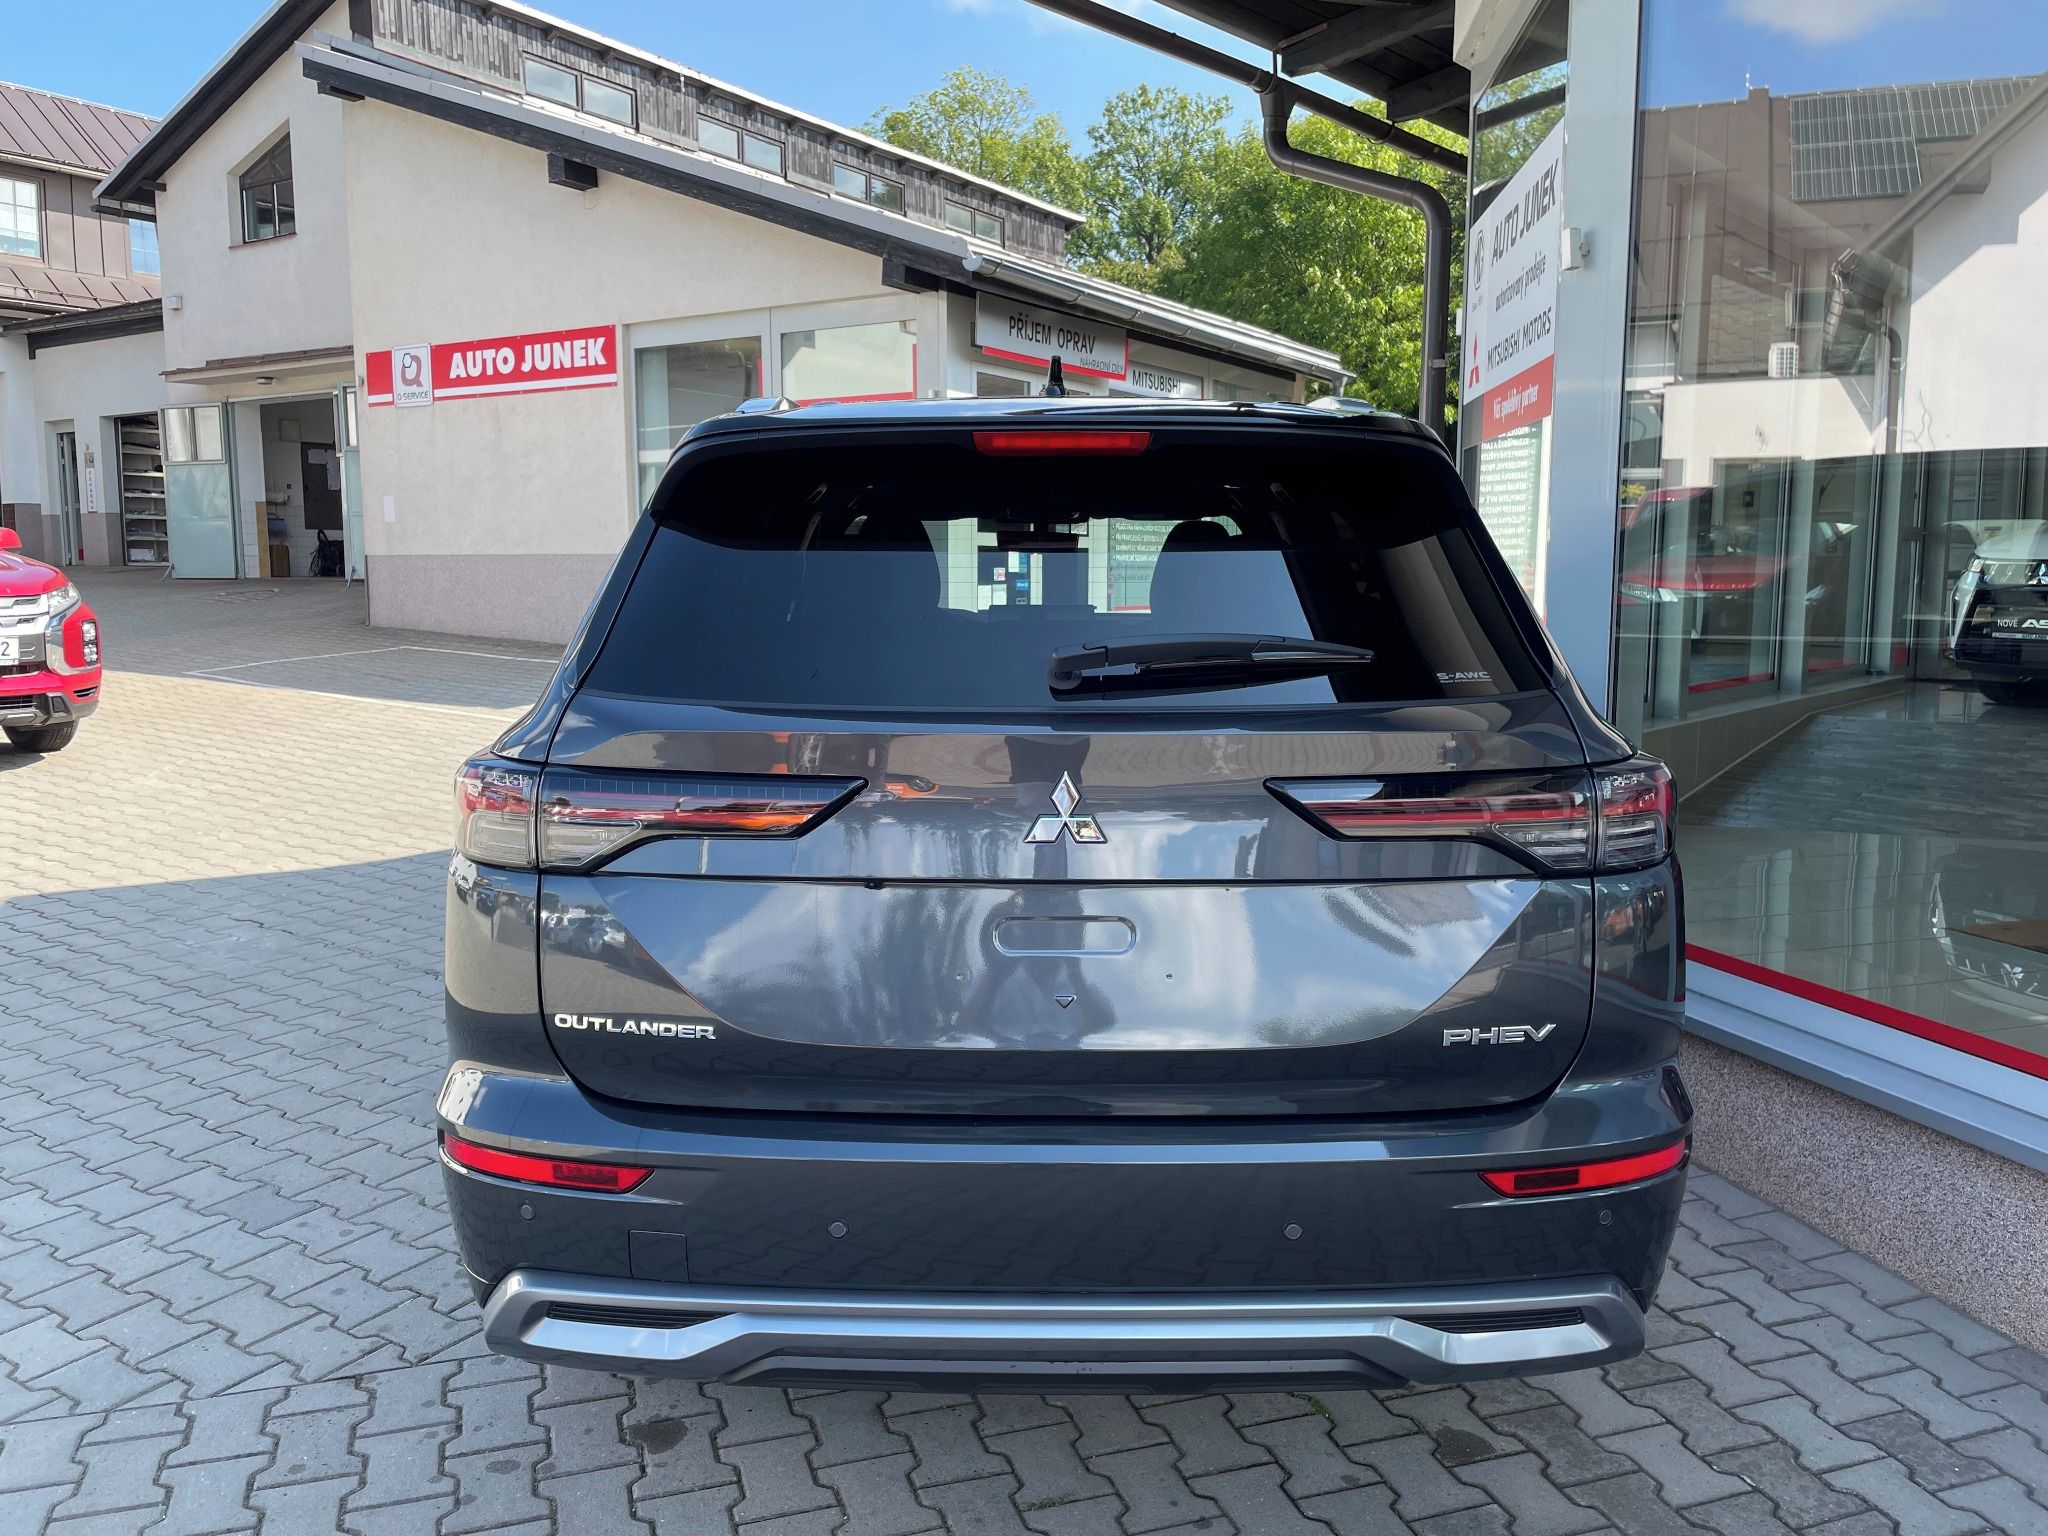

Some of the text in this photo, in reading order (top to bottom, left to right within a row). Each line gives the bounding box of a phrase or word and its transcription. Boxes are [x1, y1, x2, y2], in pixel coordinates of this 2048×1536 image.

[1491, 158, 1559, 266] AUTO JUNEK
[1009, 312, 1096, 355] PŘÍJEM OPRAV
[1487, 306, 1552, 371] MITSUBISHI MOTORS
[450, 337, 607, 379] AUTO JUNEK
[1080, 357, 1112, 372] NÁHRADNÍ
[1132, 369, 1181, 395] MITSUBISHI
[1997, 618, 2018, 628] NOVÉ
[0, 641, 10, 656] 2
[1436, 671, 1491, 680] S-AWC
[554, 1013, 717, 1040] OUTLANDER
[1442, 1023, 1557, 1047] PHEV
